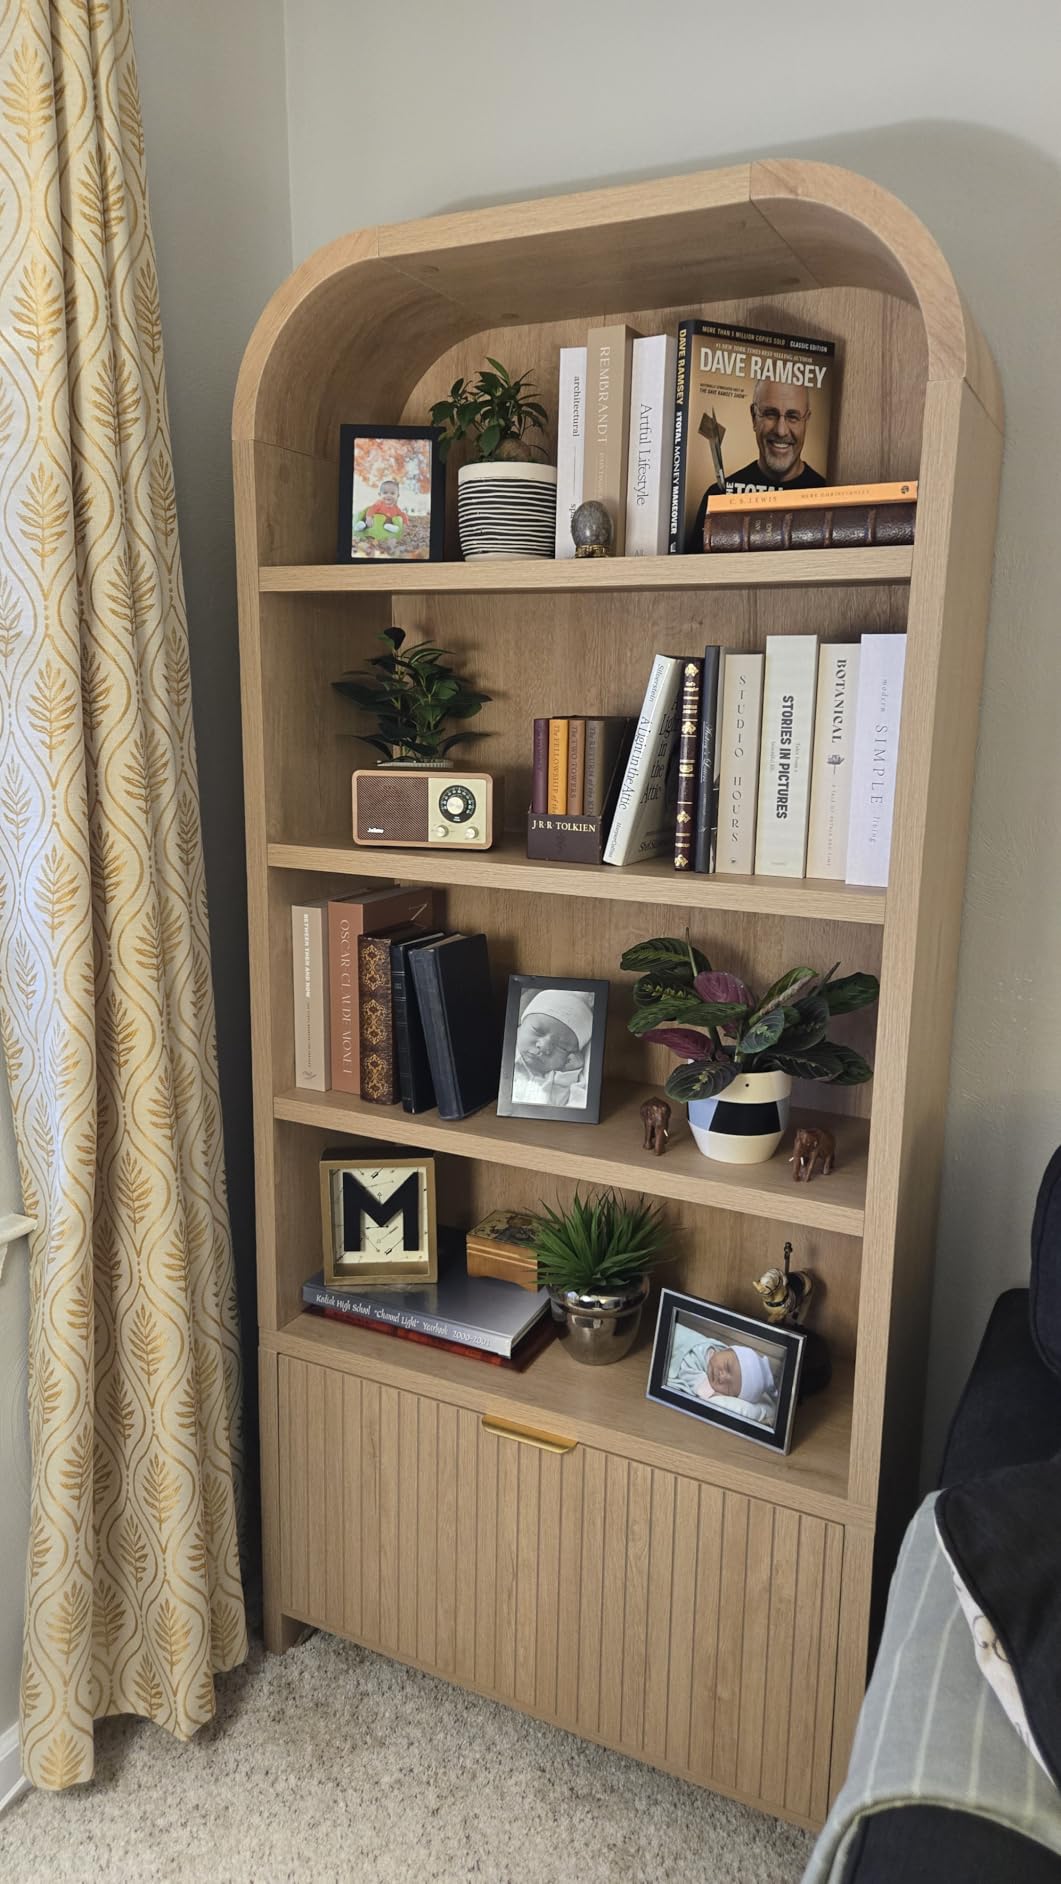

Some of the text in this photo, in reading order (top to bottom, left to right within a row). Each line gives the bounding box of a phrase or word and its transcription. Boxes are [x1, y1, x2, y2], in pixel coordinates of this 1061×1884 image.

[678, 329, 687, 358] DAVE
[676, 359, 686, 404] RAMSEY
[700, 347, 827, 388] DAVE RAMSEY
[572, 376, 581, 437] architectural
[597, 346, 611, 444] REMBRANDT
[675, 416, 683, 445] TOTAL
[634, 404, 652, 505] Artful Lifestyle
[670, 486, 679, 534] MAKEOVER
[649, 664, 664, 702] Silverstein
[832, 660, 847, 744] BOTANICAL
[627, 768, 639, 784] the
[651, 760, 665, 777] the
[731, 676, 747, 842] STUDIO HOURS
[776, 695, 794, 820] STORIES IN PICTURES
[870, 725, 888, 803] SIMPLE
[620, 784, 635, 810] Attic
[556, 822, 596, 832] TOLKIEN
[342, 1031, 353, 1076] MONET
[343, 1172, 419, 1252] M
[336, 1299, 350, 1312] High
[352, 1303, 371, 1315] School
[423, 1322, 448, 1335] Yearbook
